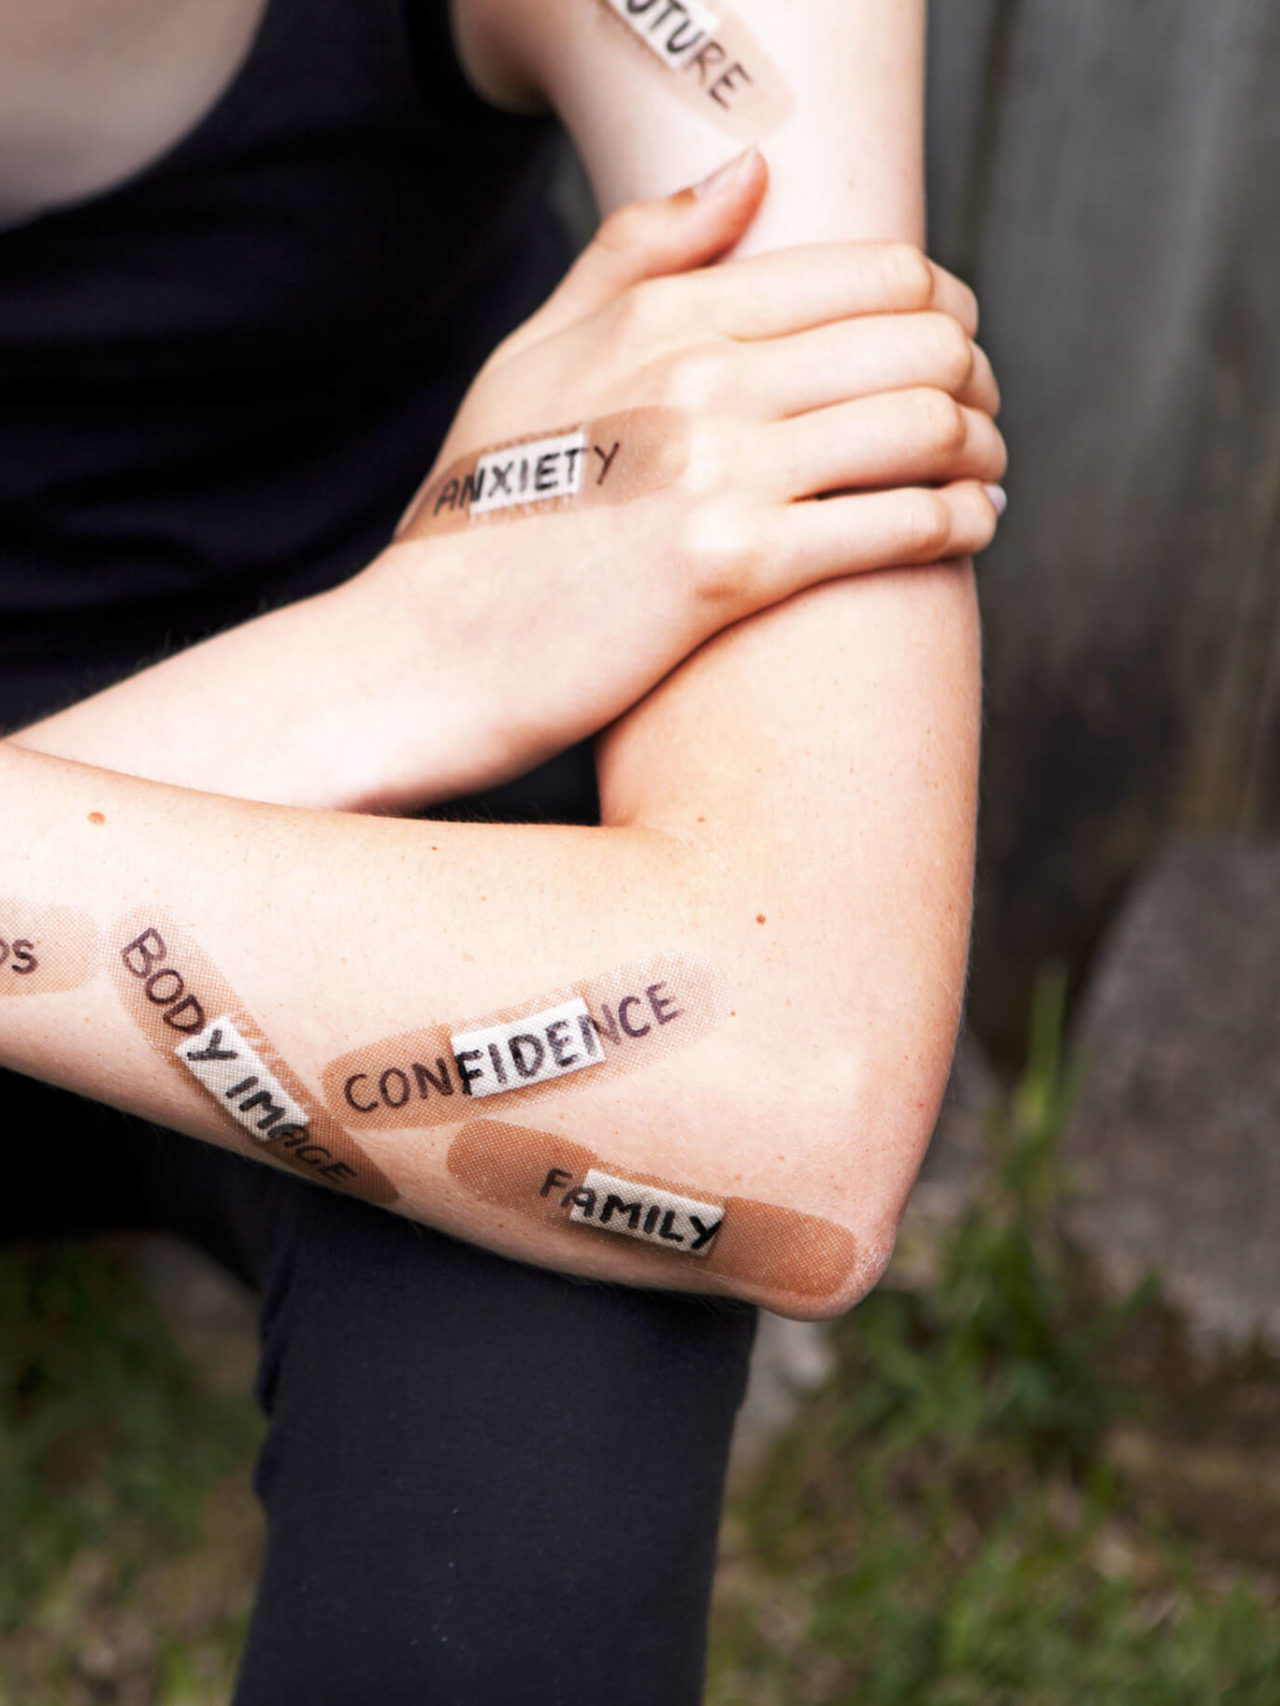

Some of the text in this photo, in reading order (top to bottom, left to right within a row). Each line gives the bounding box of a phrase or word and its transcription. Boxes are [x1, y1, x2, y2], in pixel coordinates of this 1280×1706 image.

[433, 442, 620, 516] ANXIETY
[121, 927, 358, 1181] BODY IMAGE
[343, 980, 686, 1114] CONFIDENCE
[540, 1167, 724, 1251] FAMILY
